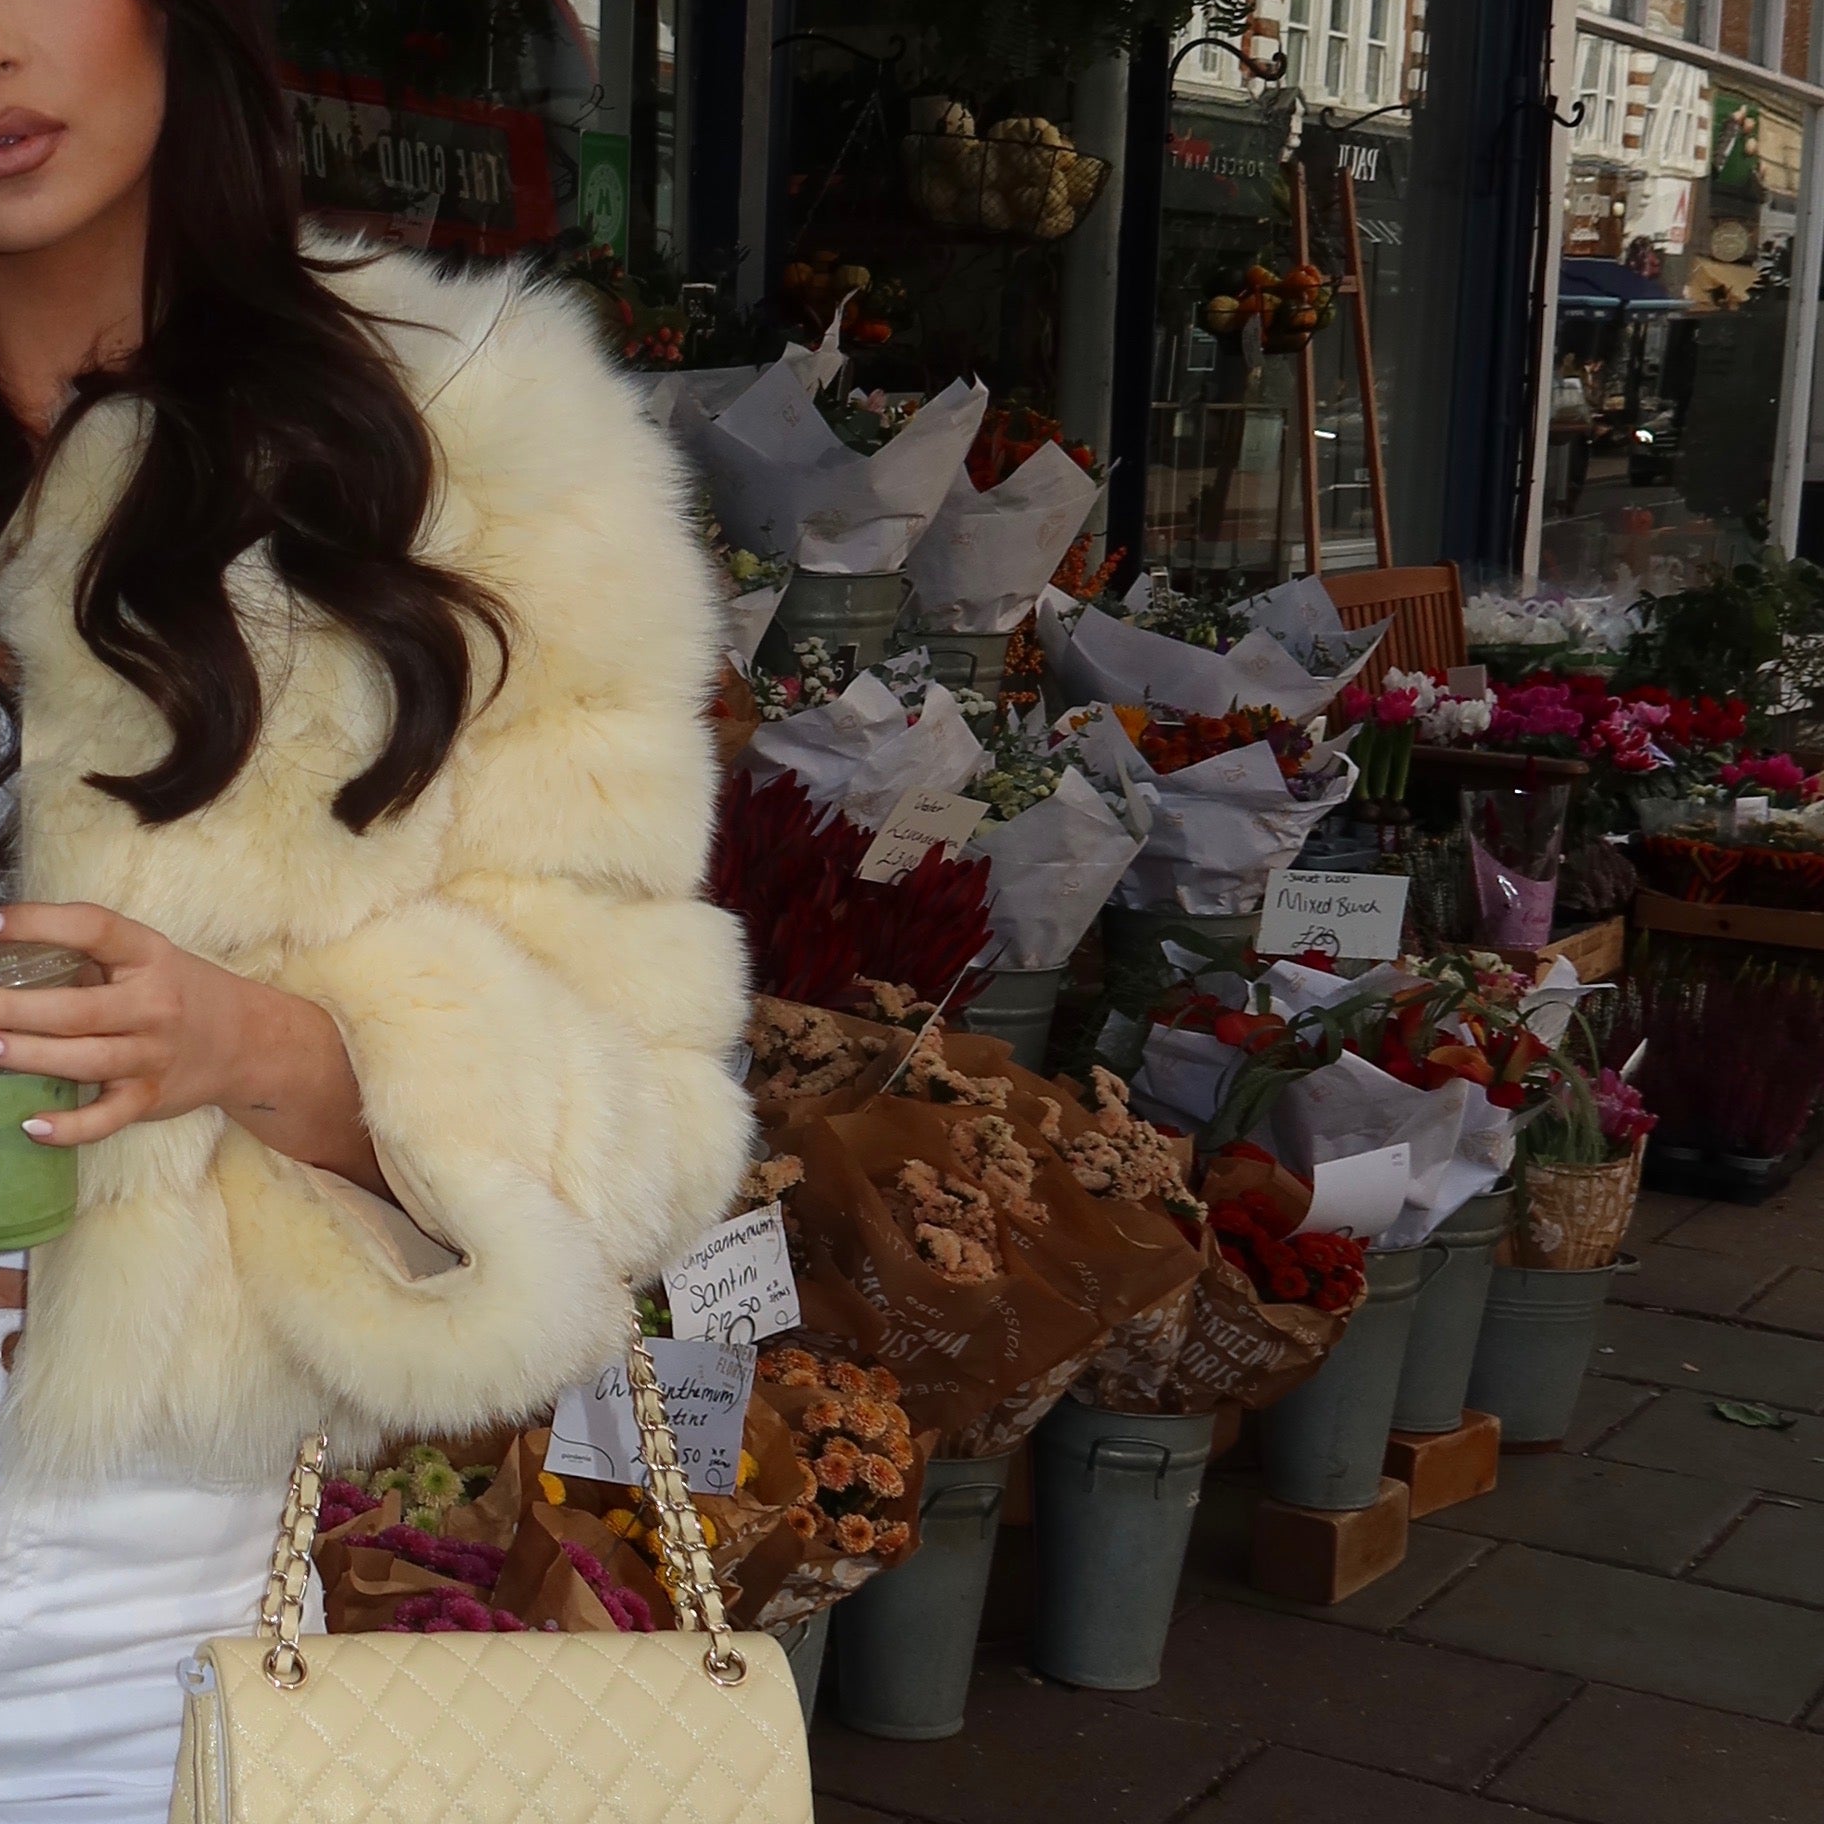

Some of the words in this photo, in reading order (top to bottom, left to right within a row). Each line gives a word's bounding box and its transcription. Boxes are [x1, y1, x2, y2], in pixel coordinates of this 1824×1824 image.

[1277, 888, 1332, 914] Mixed
[1336, 896, 1381, 917] Bunch
[987, 1294, 1022, 1363] PASSION
